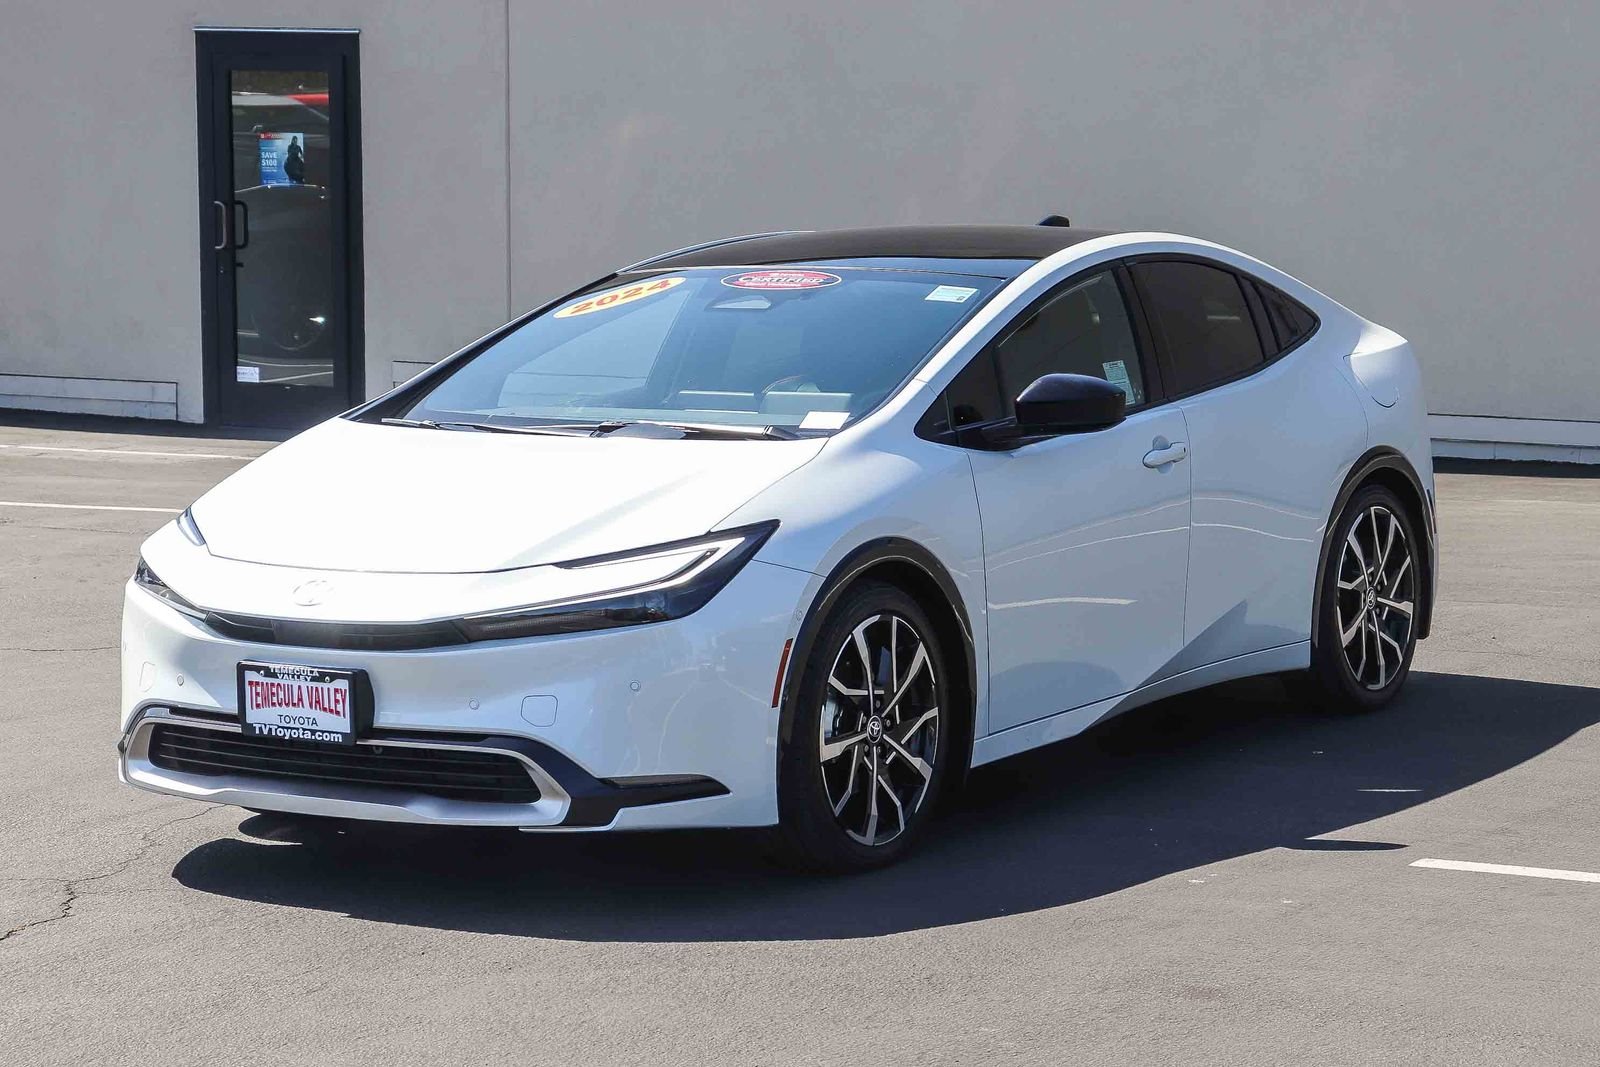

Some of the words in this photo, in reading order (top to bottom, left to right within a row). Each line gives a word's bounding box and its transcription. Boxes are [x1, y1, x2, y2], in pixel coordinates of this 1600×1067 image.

[261, 151, 278, 159] SAVE
[261, 159, 278, 167] $100
[570, 279, 671, 314] 2024
[269, 665, 319, 677] TEMECULA
[277, 673, 312, 682] VALLEY
[248, 680, 305, 711] TEMECULA
[306, 685, 347, 718] VALLEY
[278, 714, 319, 727] TOYOTA
[253, 723, 343, 742] TVToyota.com
